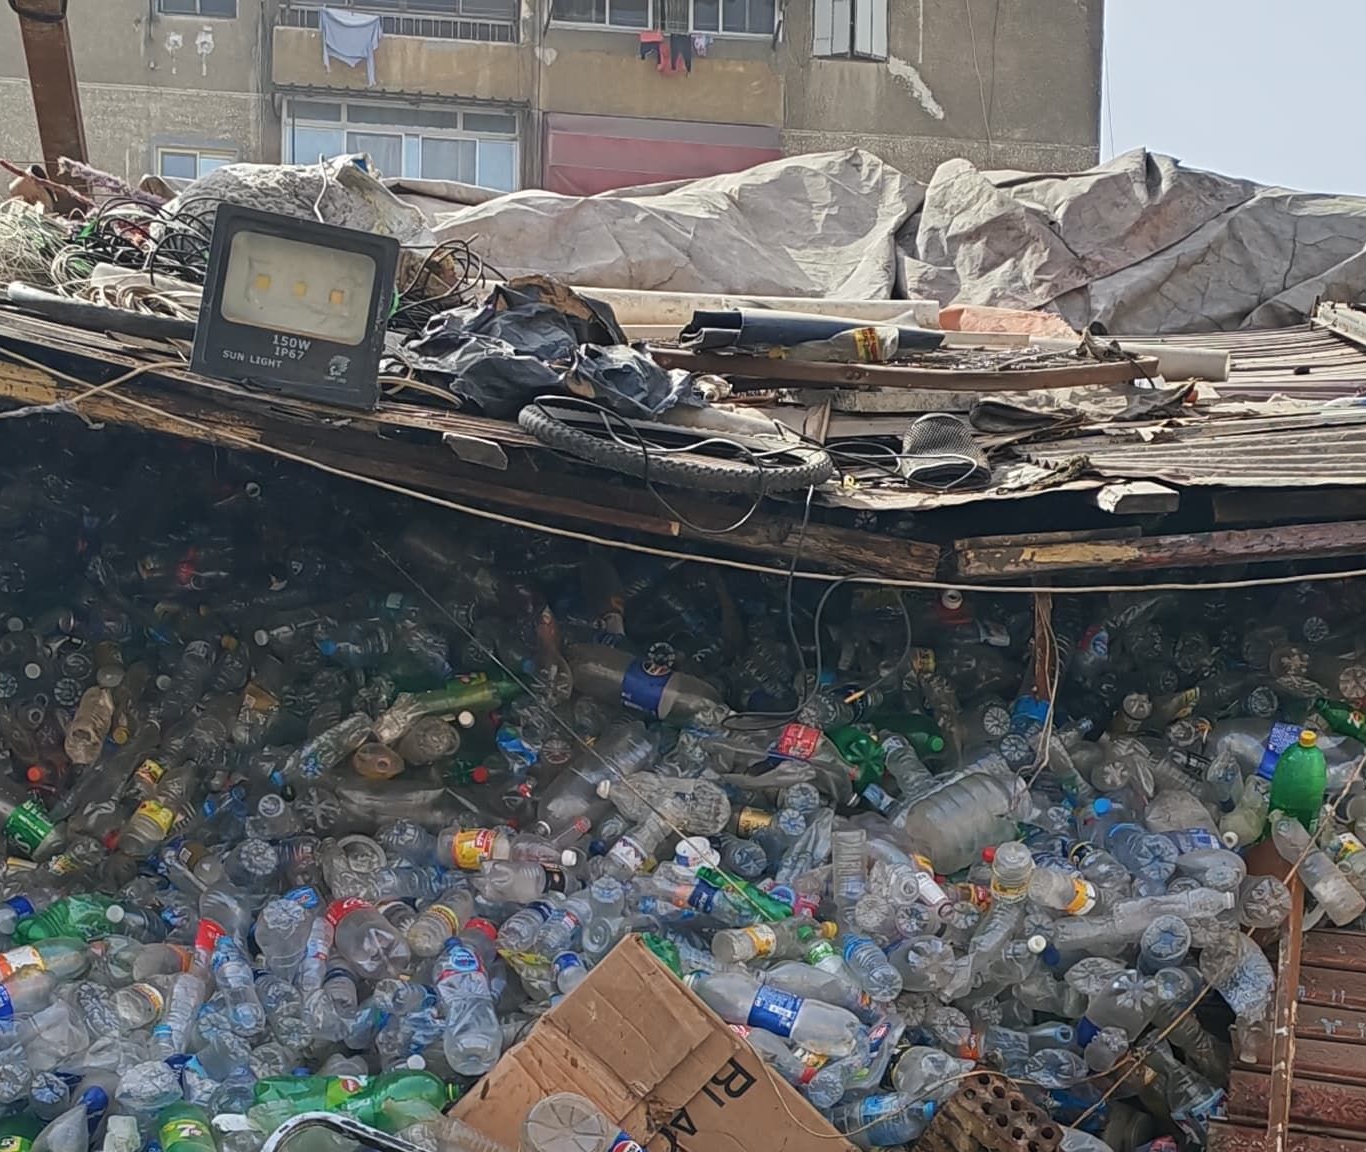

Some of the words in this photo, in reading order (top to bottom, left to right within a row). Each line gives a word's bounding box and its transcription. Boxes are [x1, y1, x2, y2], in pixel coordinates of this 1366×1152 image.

[273, 334, 311, 351] 150W
[222, 350, 245, 361] SUN
[249, 355, 283, 368] LIGHT
[275, 346, 305, 360] IP67
